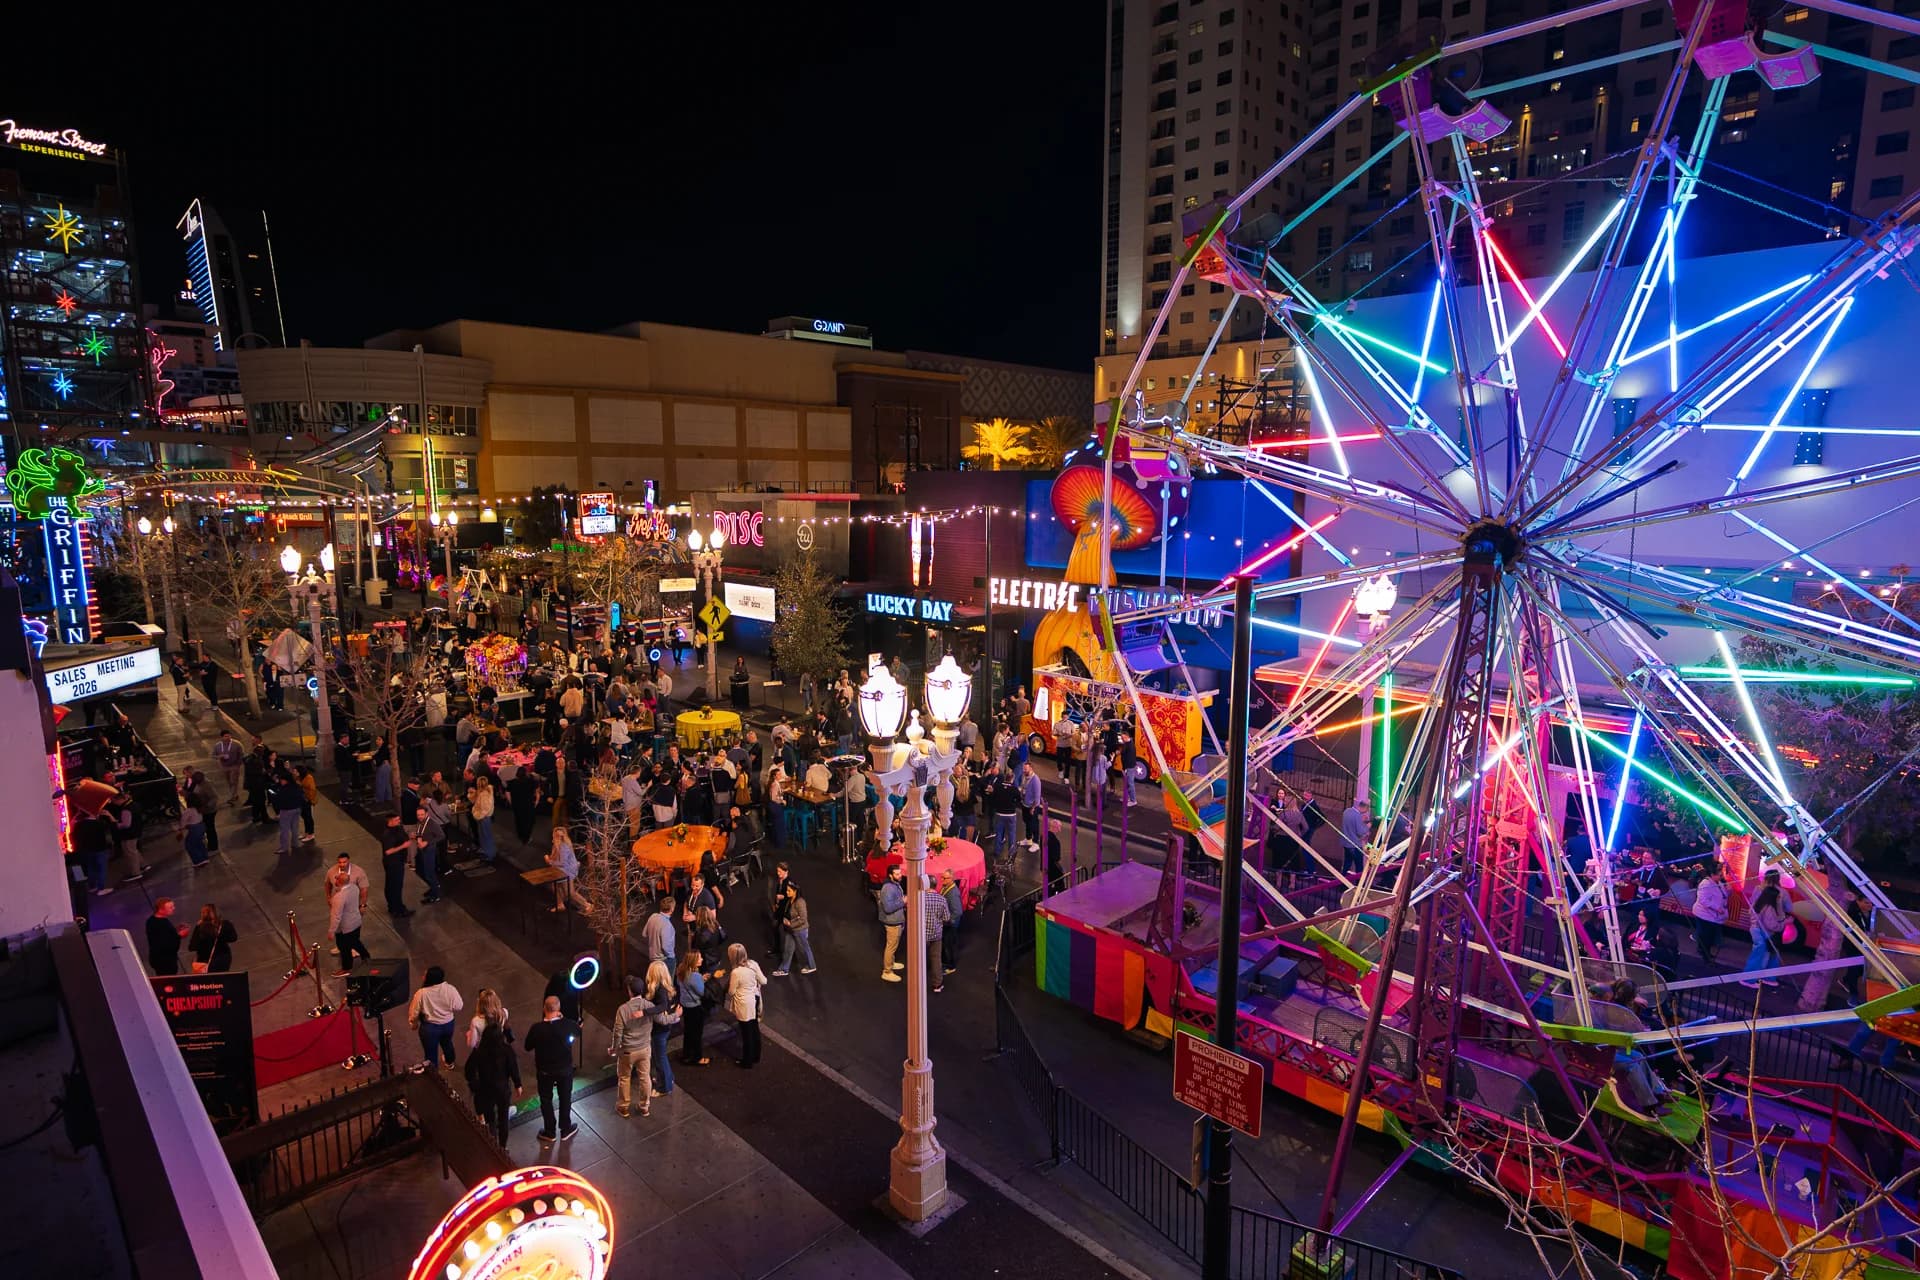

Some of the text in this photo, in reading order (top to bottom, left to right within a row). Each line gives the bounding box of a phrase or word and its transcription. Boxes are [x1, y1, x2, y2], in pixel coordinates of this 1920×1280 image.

[0, 119, 107, 156] Fremont Street
[20, 143, 86, 161] EXPERIENCE
[813, 319, 846, 333] GRAND
[47, 496, 68, 507] THE
[50, 508, 84, 644] GRIFFIN
[866, 593, 953, 622] LUCKY DAY
[990, 577, 1080, 614] ELECTRIC
[54, 656, 135, 687] SALES MEETING
[72, 680, 98, 698] 2026
[1191, 1041, 1245, 1070] PROHIBITED
[1191, 1054, 1245, 1084] WITHIN PUBLIC
[1186, 1079, 1195, 1088] NO
[1192, 1072, 1242, 1101] OR SIDEWALK
[1193, 1064, 1241, 1090] RIGHT-OF-WAY
